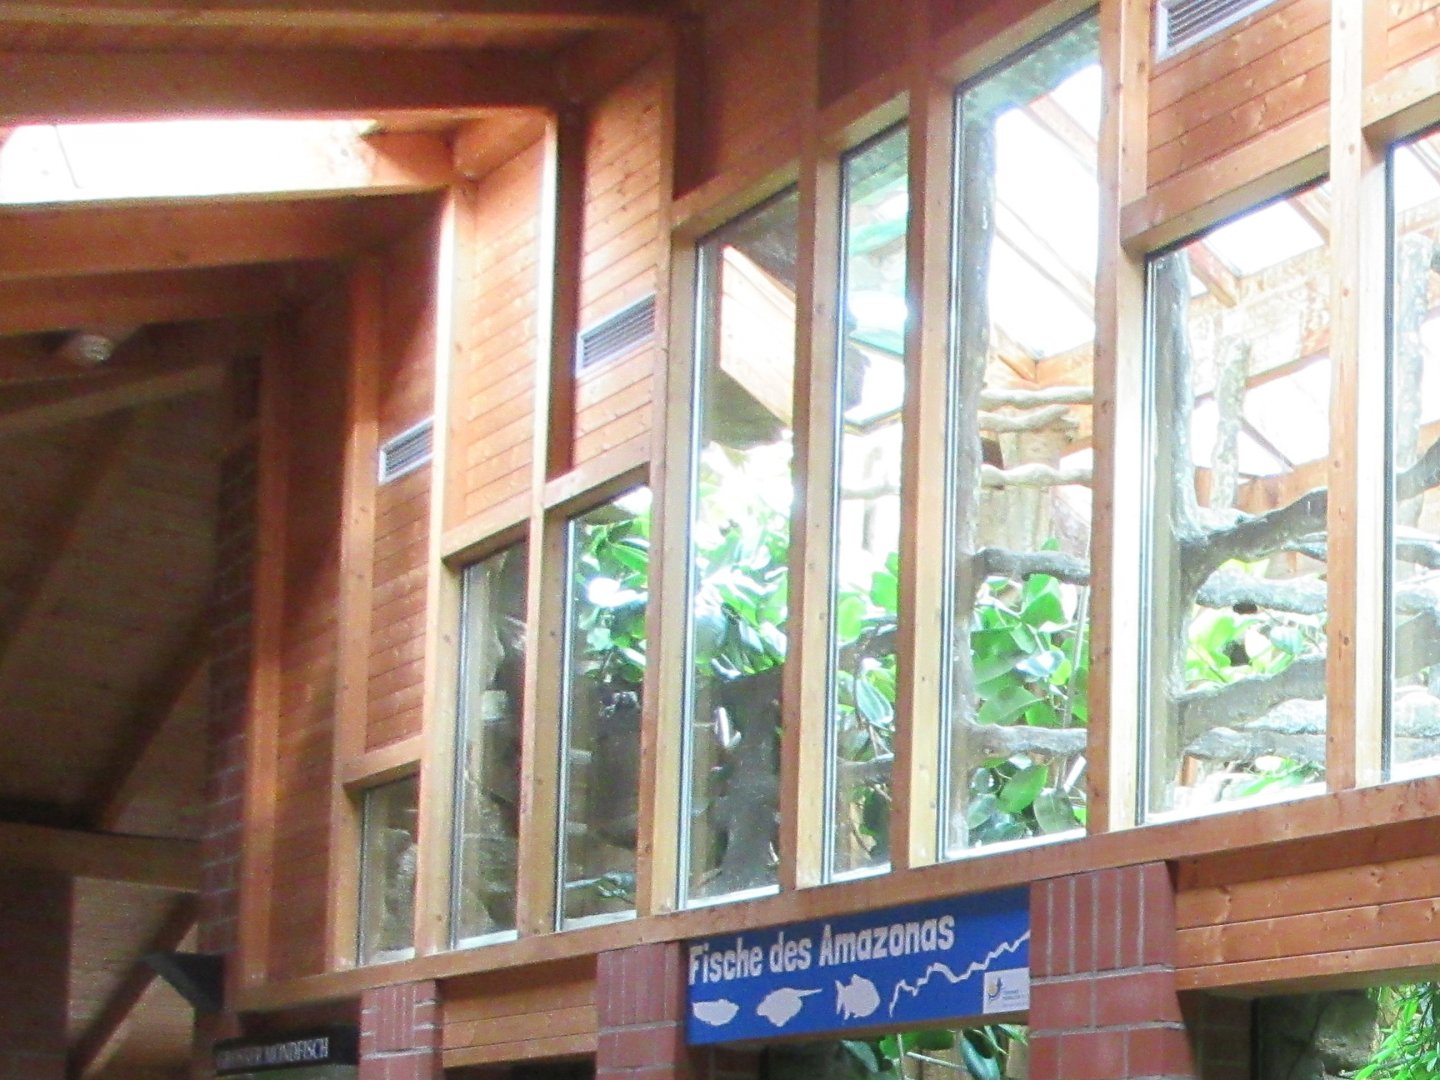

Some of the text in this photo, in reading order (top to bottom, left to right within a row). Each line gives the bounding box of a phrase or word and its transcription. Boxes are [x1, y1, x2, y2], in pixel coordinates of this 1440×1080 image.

[688, 914, 955, 985] Fische des Amazonas
